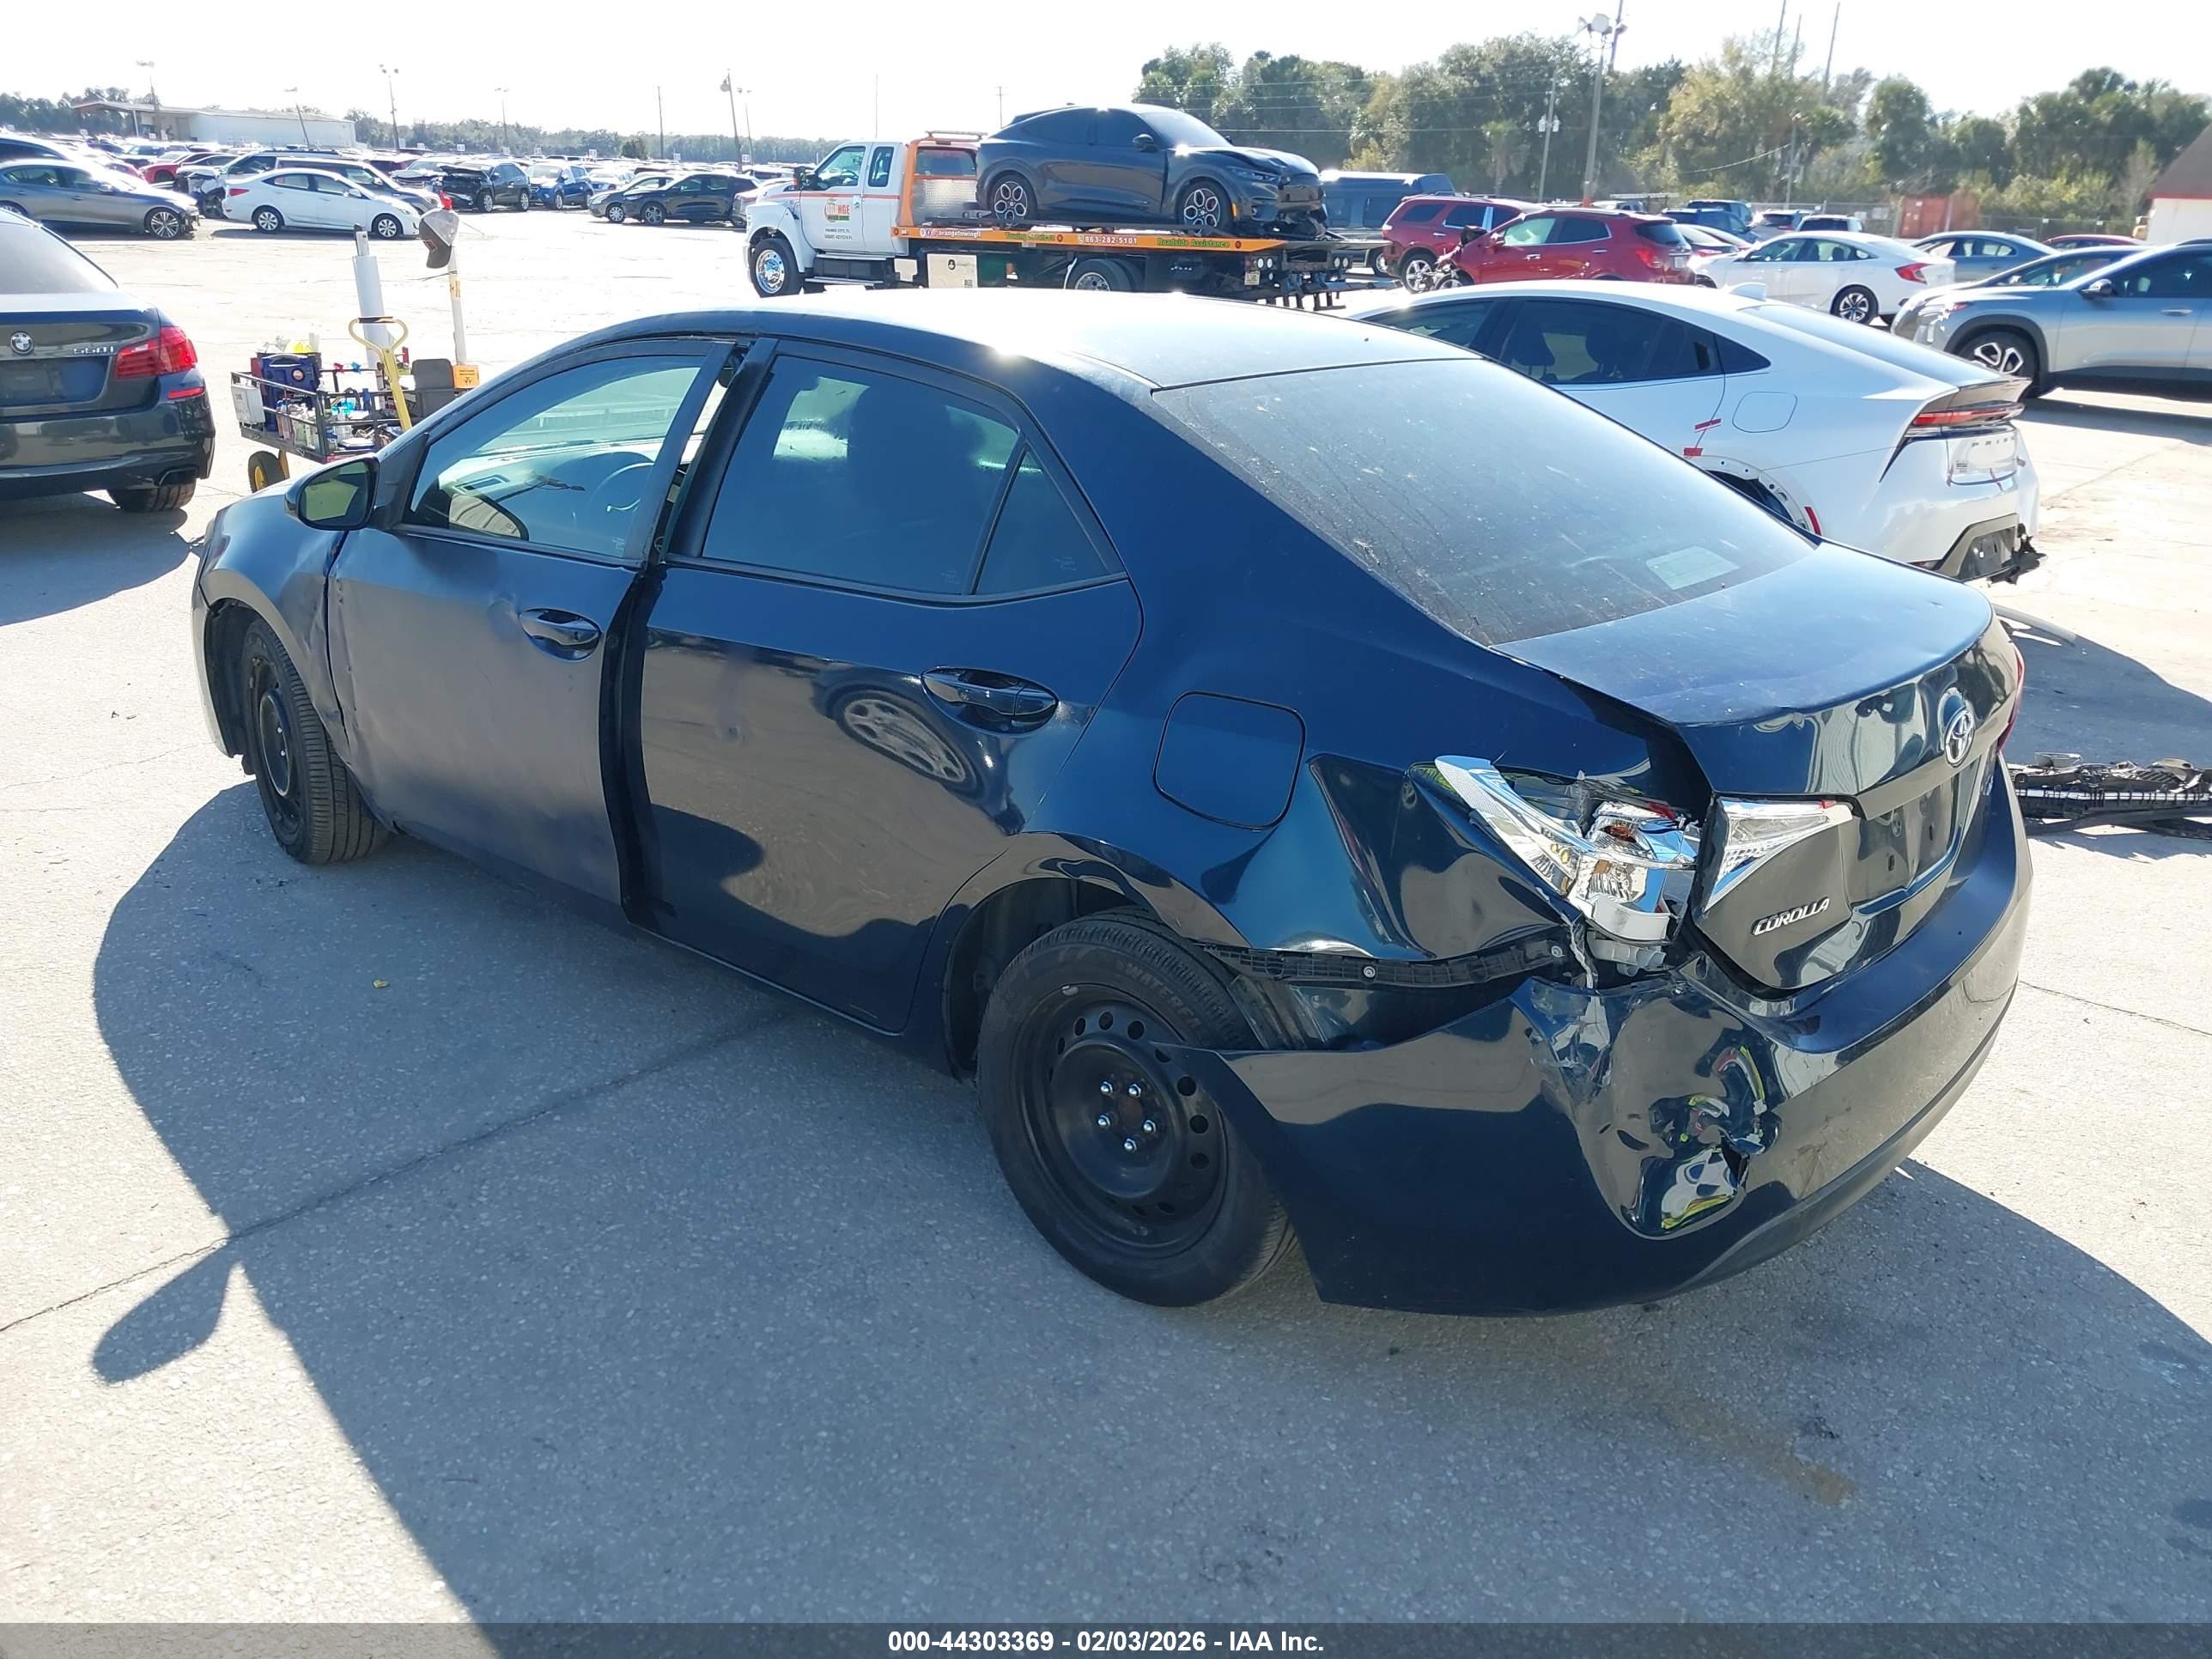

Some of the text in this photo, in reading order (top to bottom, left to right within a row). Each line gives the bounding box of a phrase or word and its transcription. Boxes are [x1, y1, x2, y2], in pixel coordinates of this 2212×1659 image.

[1085, 235, 1138, 245] 863-282-5101
[1157, 237, 1230, 248] Roadside Assistance
[1753, 897, 1830, 936] COROLLA
